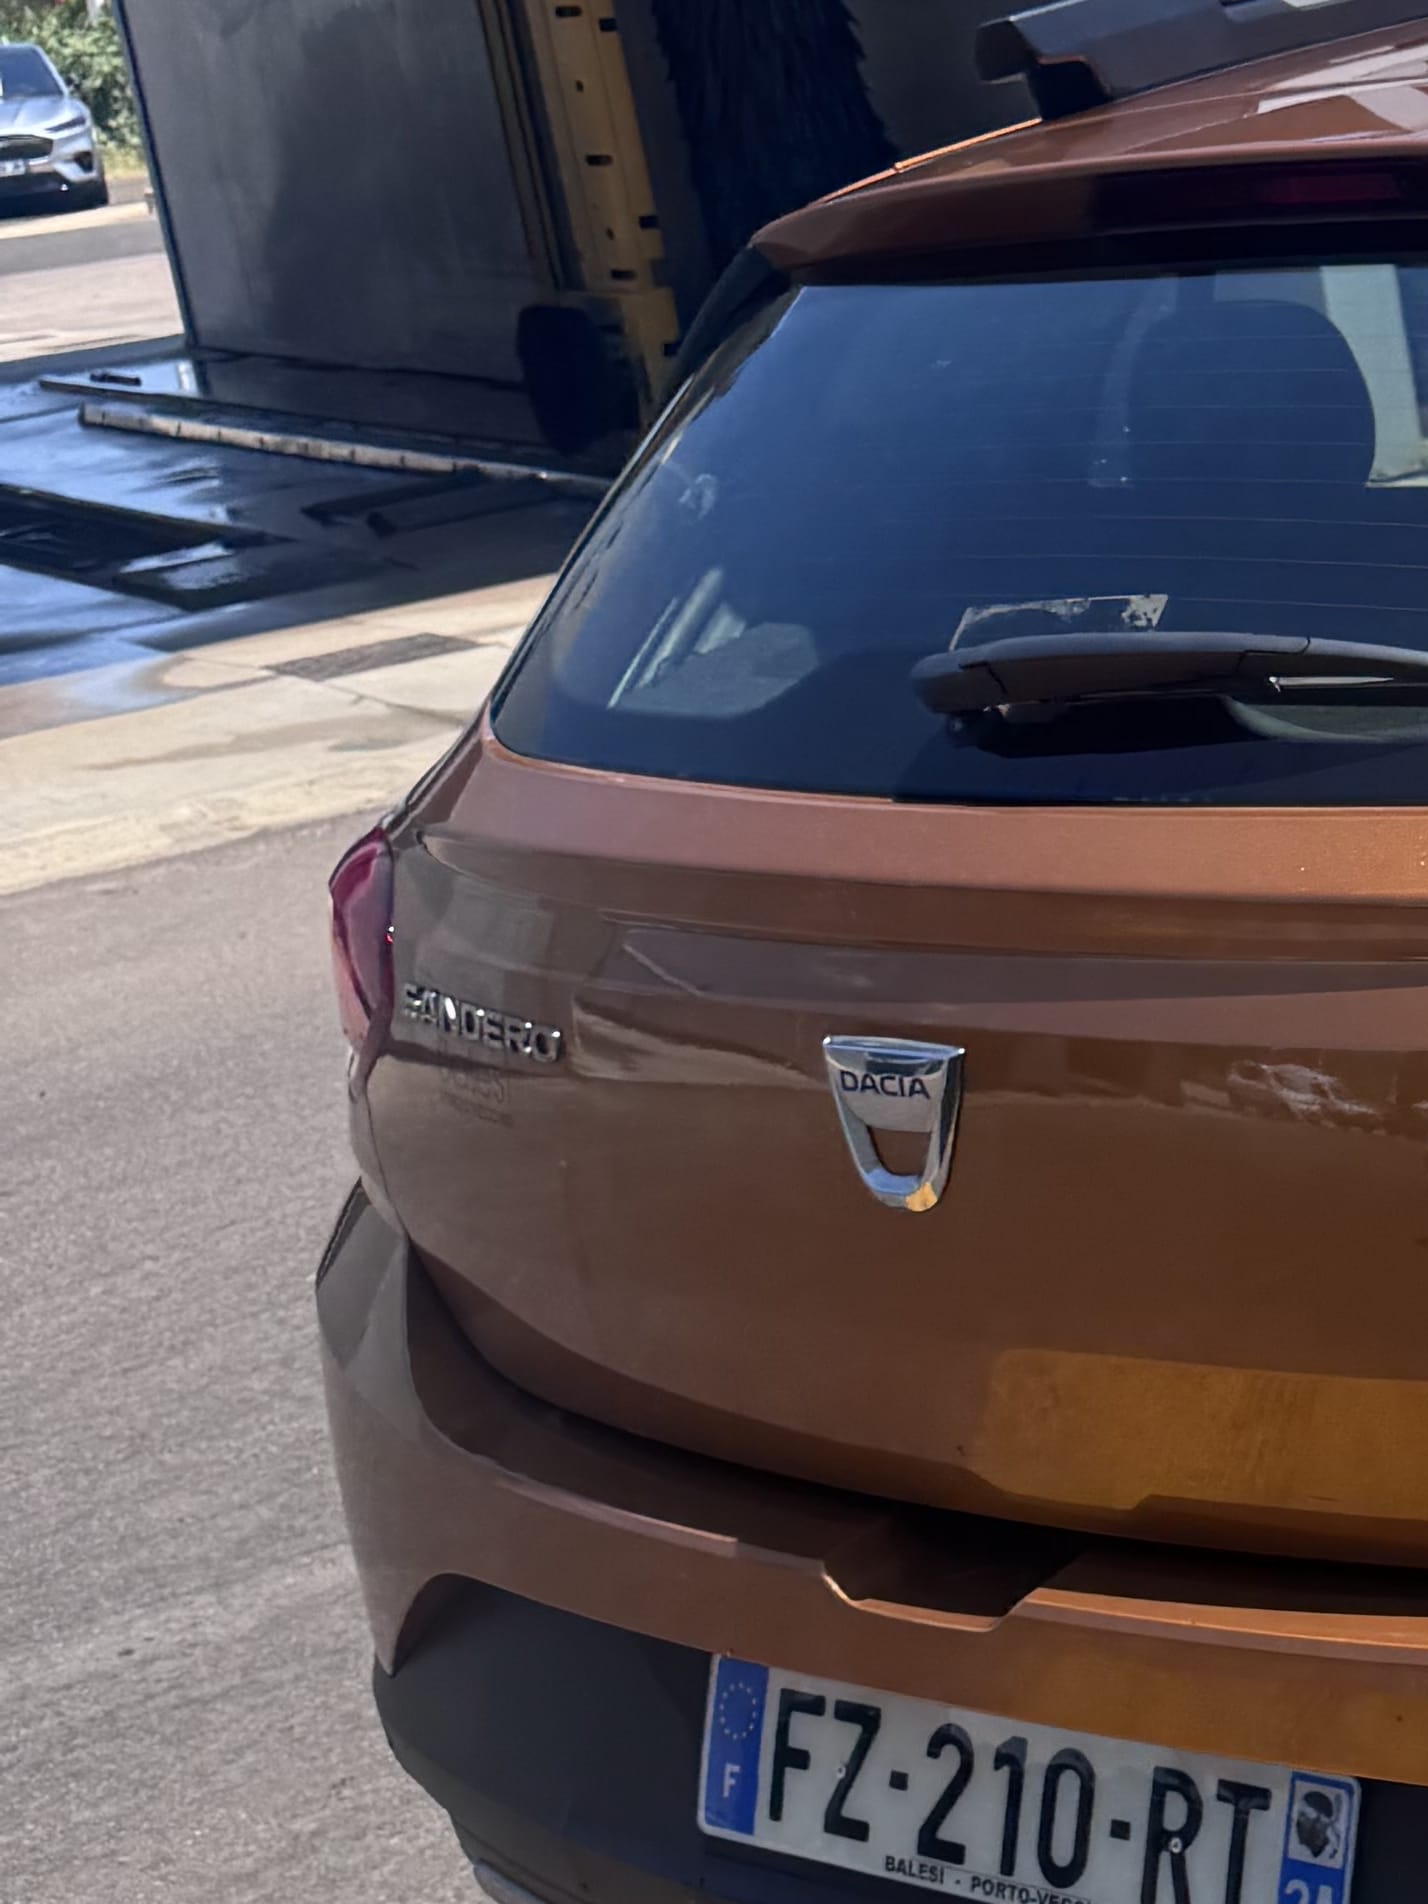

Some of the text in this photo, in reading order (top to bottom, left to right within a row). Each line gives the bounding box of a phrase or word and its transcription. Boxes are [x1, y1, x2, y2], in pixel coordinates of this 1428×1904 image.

[402, 983, 561, 1062] SANDERO
[840, 1070, 930, 1100] DACIA
[722, 1762, 741, 1799] F
[884, 1855, 945, 1884] BALESI
